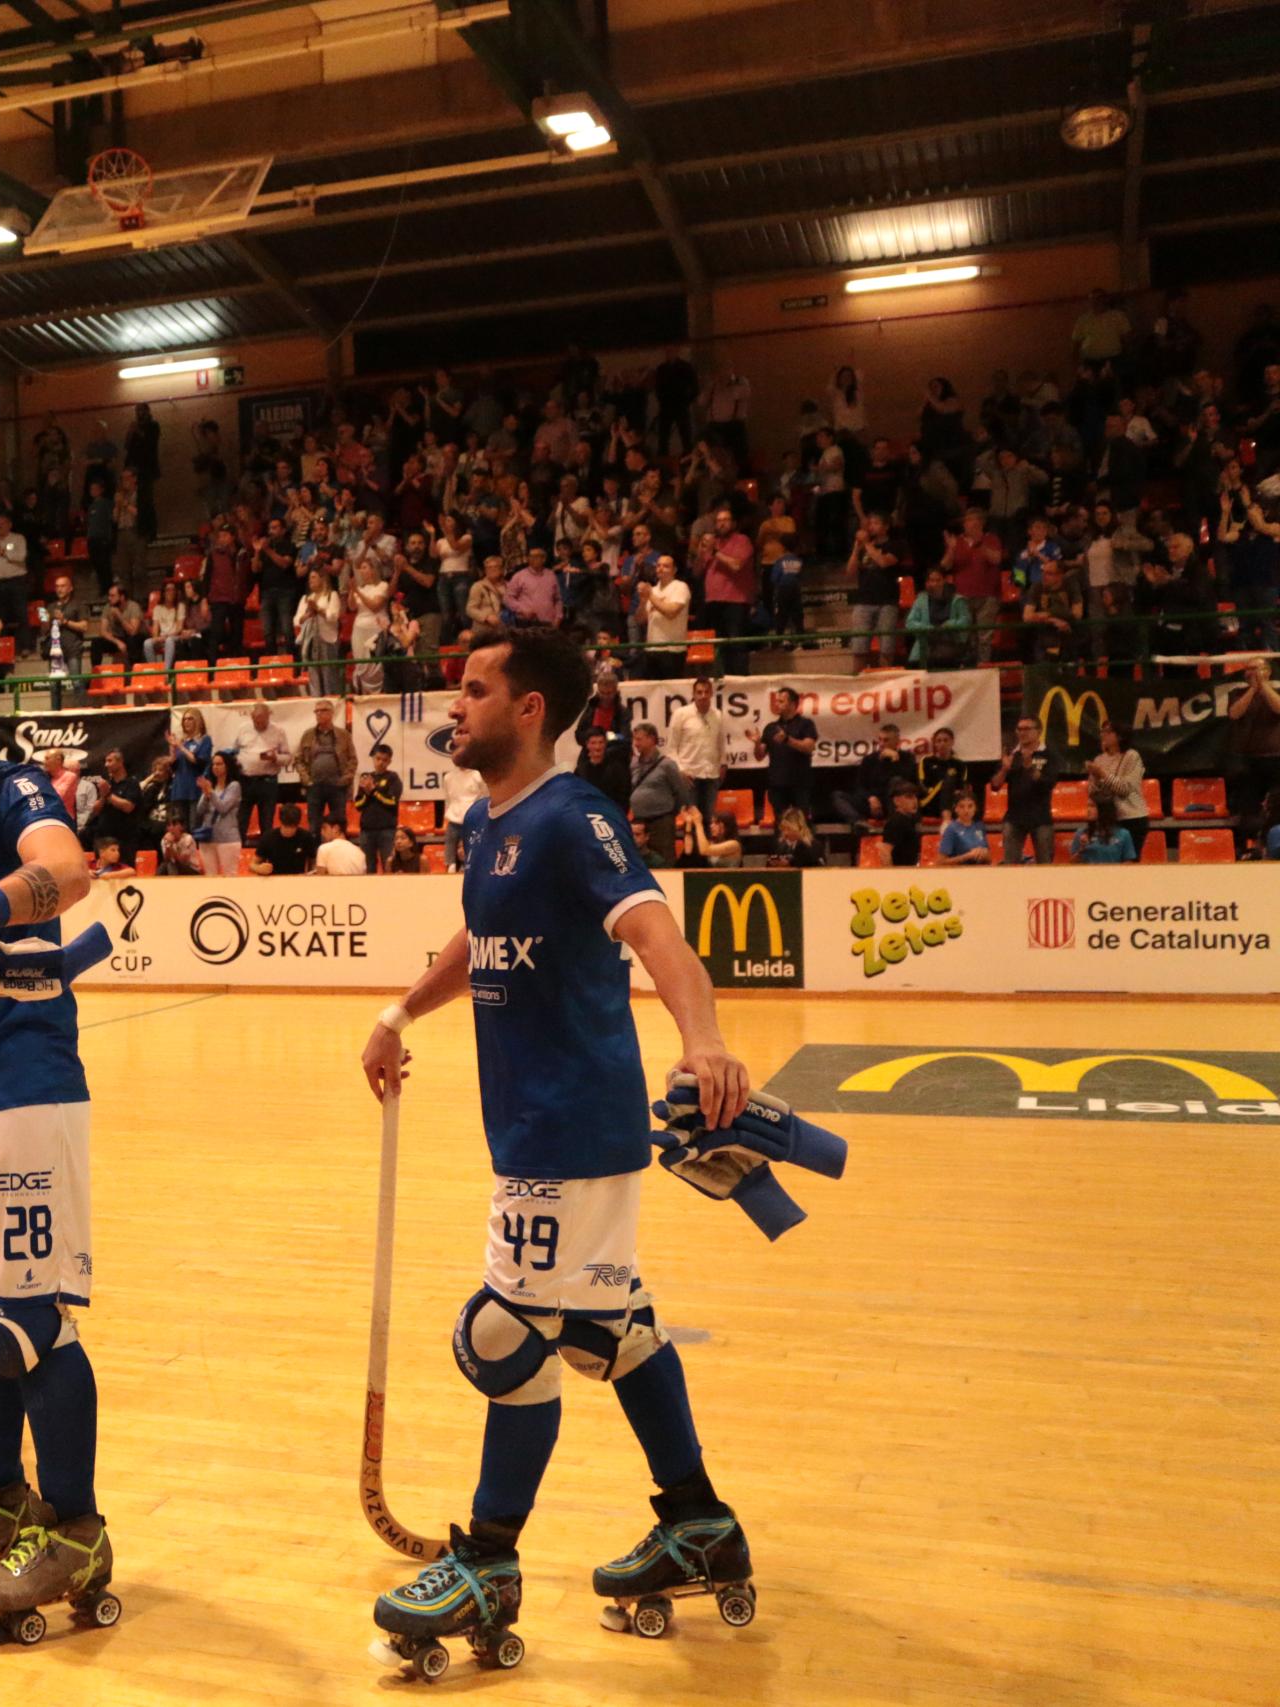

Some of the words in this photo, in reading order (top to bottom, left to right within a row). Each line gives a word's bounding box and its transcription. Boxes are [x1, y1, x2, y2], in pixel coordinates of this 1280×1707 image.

[830, 679, 953, 722] equip
[14, 720, 89, 764] Sansi
[257, 903, 368, 927] WORLD
[850, 884, 952, 938] Peta
[1087, 900, 1240, 922] Generalitat
[257, 930, 369, 958] SKATE
[851, 915, 964, 978] Zetas
[1087, 929, 1121, 950] de
[1130, 928, 1271, 955] Catalunya
[110, 955, 153, 972] CUP
[733, 959, 795, 978] Lleida
[1017, 1096, 1280, 1117] Lleid
[505, 1179, 564, 1199] EDGE
[3, 1204, 53, 1261] 28
[502, 1211, 560, 1271] 49
